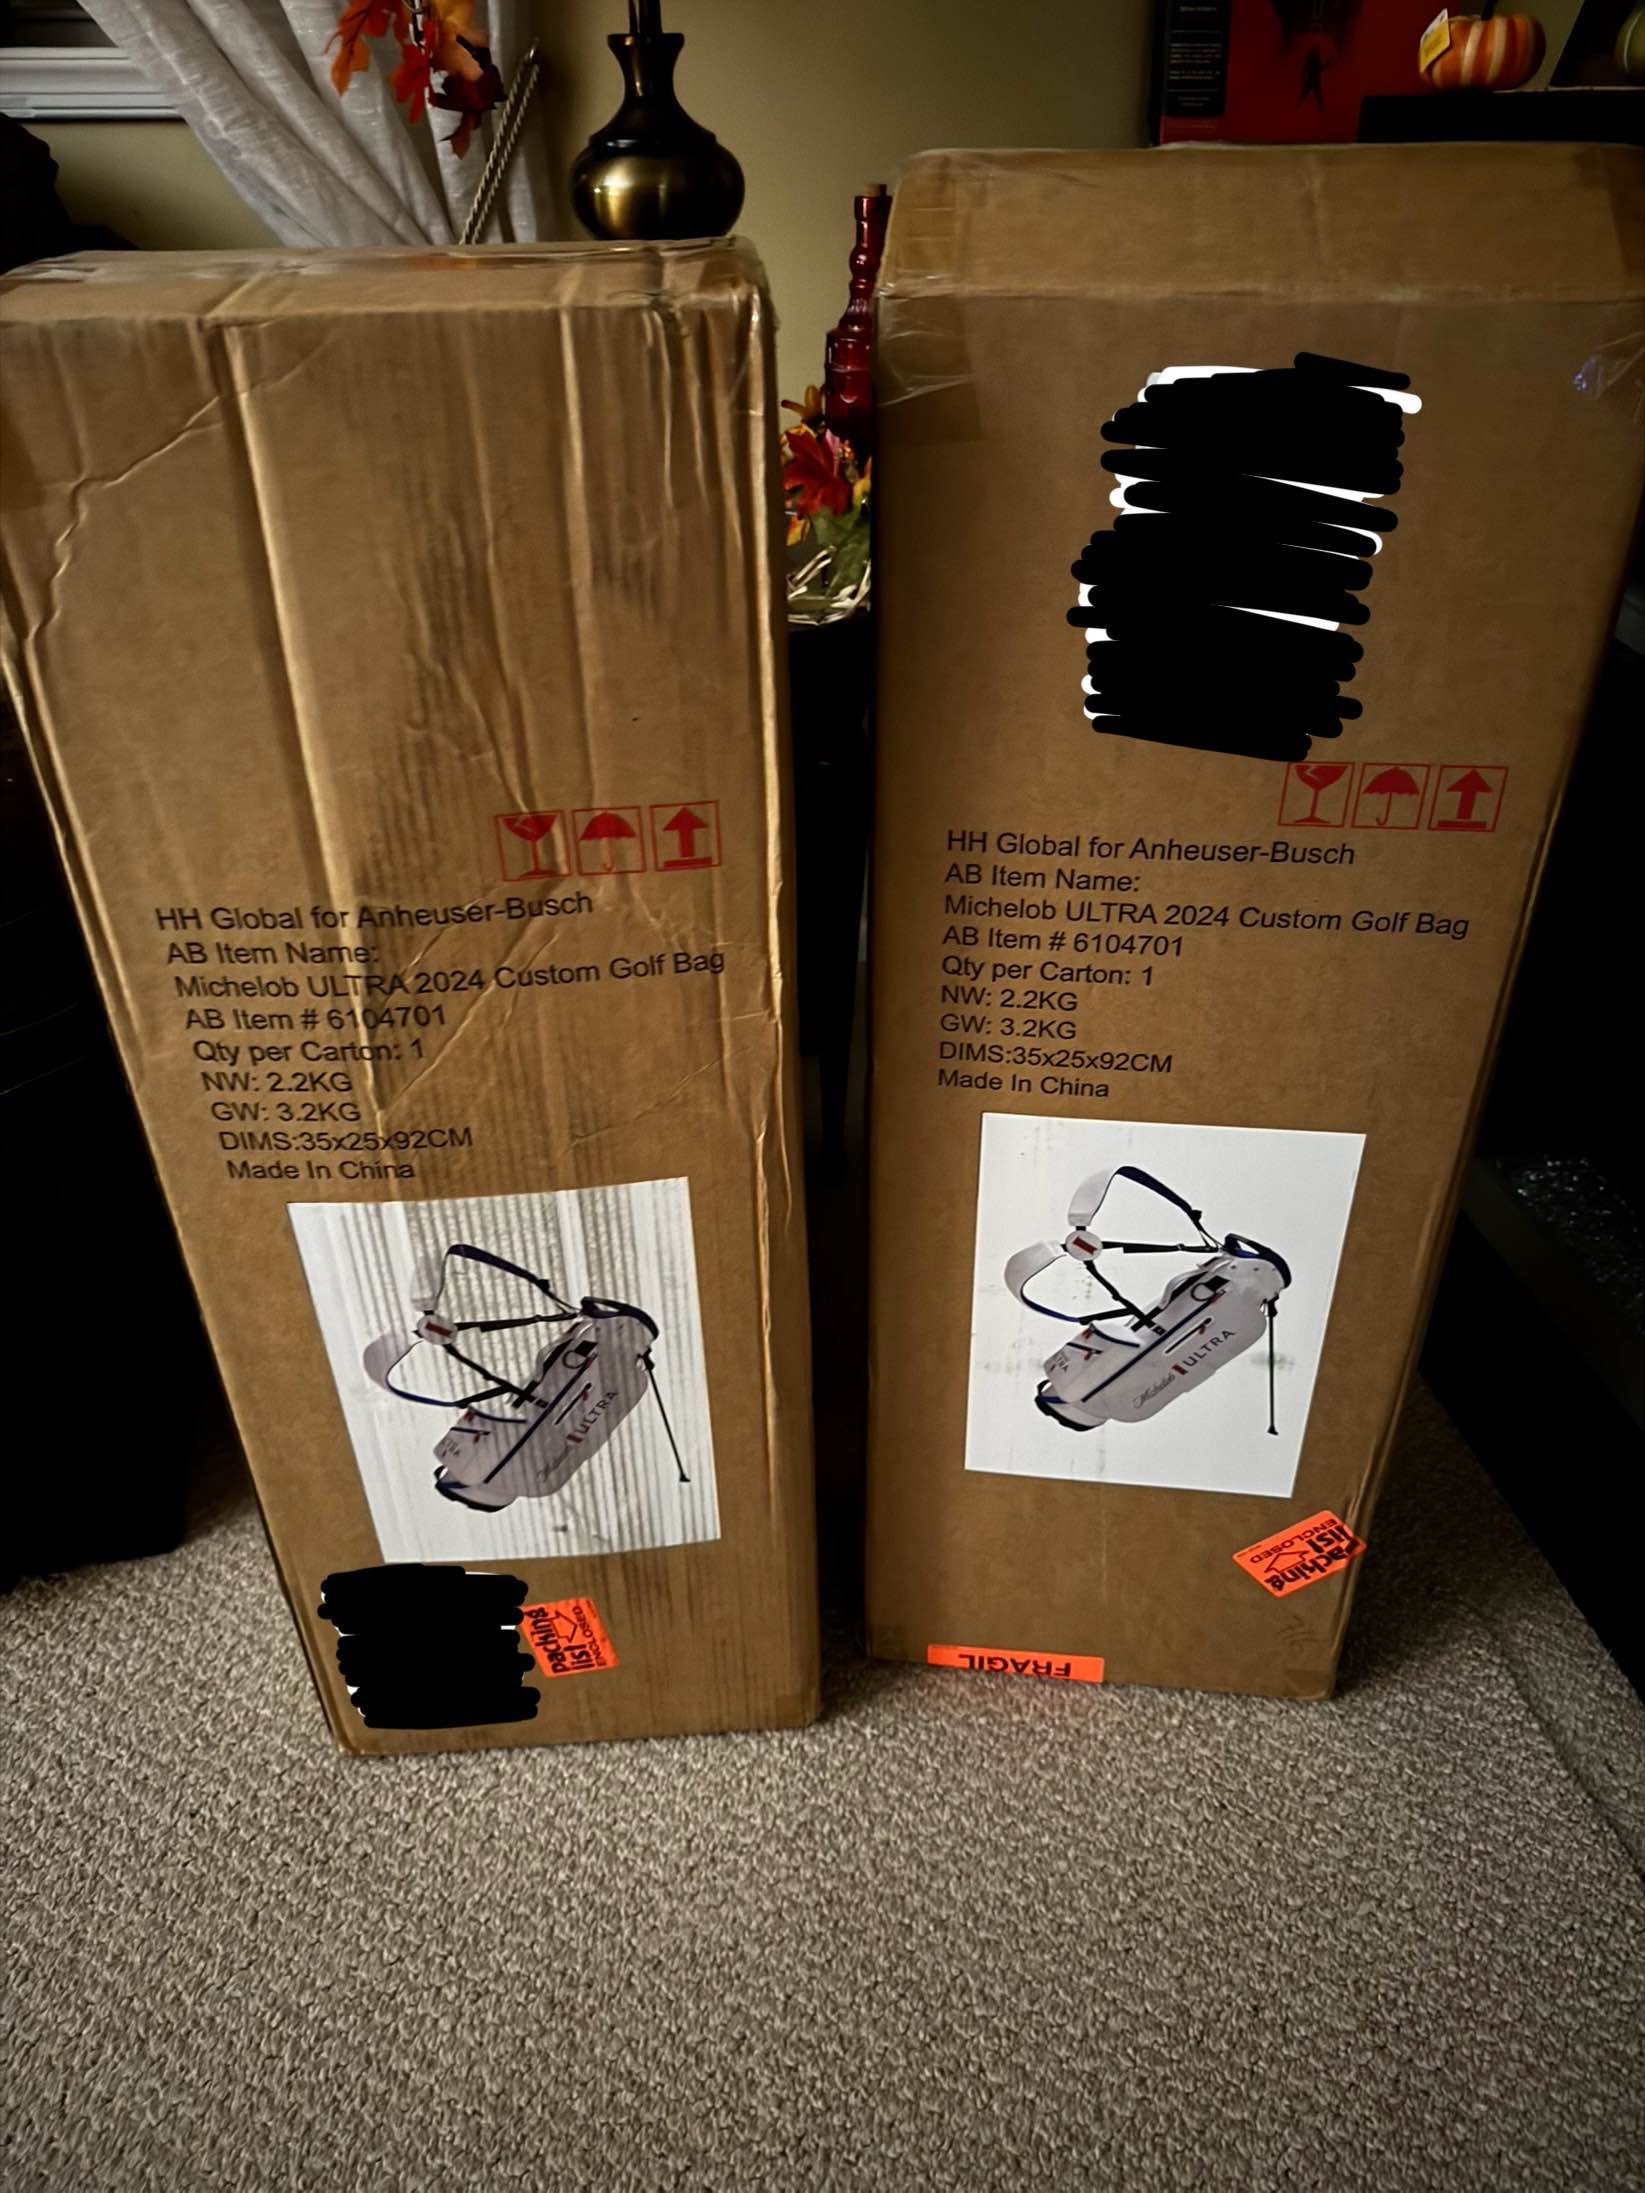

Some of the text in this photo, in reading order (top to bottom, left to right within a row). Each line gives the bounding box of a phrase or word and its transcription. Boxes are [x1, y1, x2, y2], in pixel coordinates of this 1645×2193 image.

[947, 830, 1355, 865] HH Global for Anheuser-Busch
[945, 864, 1140, 892] AB Item Name:
[156, 891, 593, 931] HH Global for Anheuser-Busch
[945, 895, 1469, 940] Michelob ULTRA 2024 Custom Golf Bag
[168, 941, 379, 964] AB Item Name:
[943, 926, 1184, 956] AB Item # 6104701
[176, 951, 725, 998] Michelob ULTRA 2024 Custom Golf Bag
[942, 956, 1153, 986] Qty per Carton: 1
[941, 985, 1078, 1012] NW: 2.2KG
[186, 1005, 445, 1029] AB Item # 6104701
[940, 1013, 1076, 1040] GW: 3.2KG
[194, 1039, 424, 1065] Qty per Carton: 1
[939, 1042, 1173, 1073] DIMS:35x25x92CM
[201, 1071, 352, 1093] NW: 2.2KG
[938, 1069, 1109, 1098] Made In China
[211, 1101, 361, 1123] GW: 3.2KG
[219, 1127, 473, 1152] DIMS:35x25x92CM
[226, 1159, 414, 1179] Made In China
[1183, 1330, 1236, 1366] ULTRA
[575, 1392, 618, 1433] ULTRA
[1250, 1518, 1338, 1563] ENCLOSED
[1306, 1525, 1351, 1553] list
[524, 1607, 571, 1673] packing
[572, 1606, 607, 1667] ENCLOSED
[563, 1644, 595, 1671] list
[958, 1654, 1071, 1677] FRAGIL
